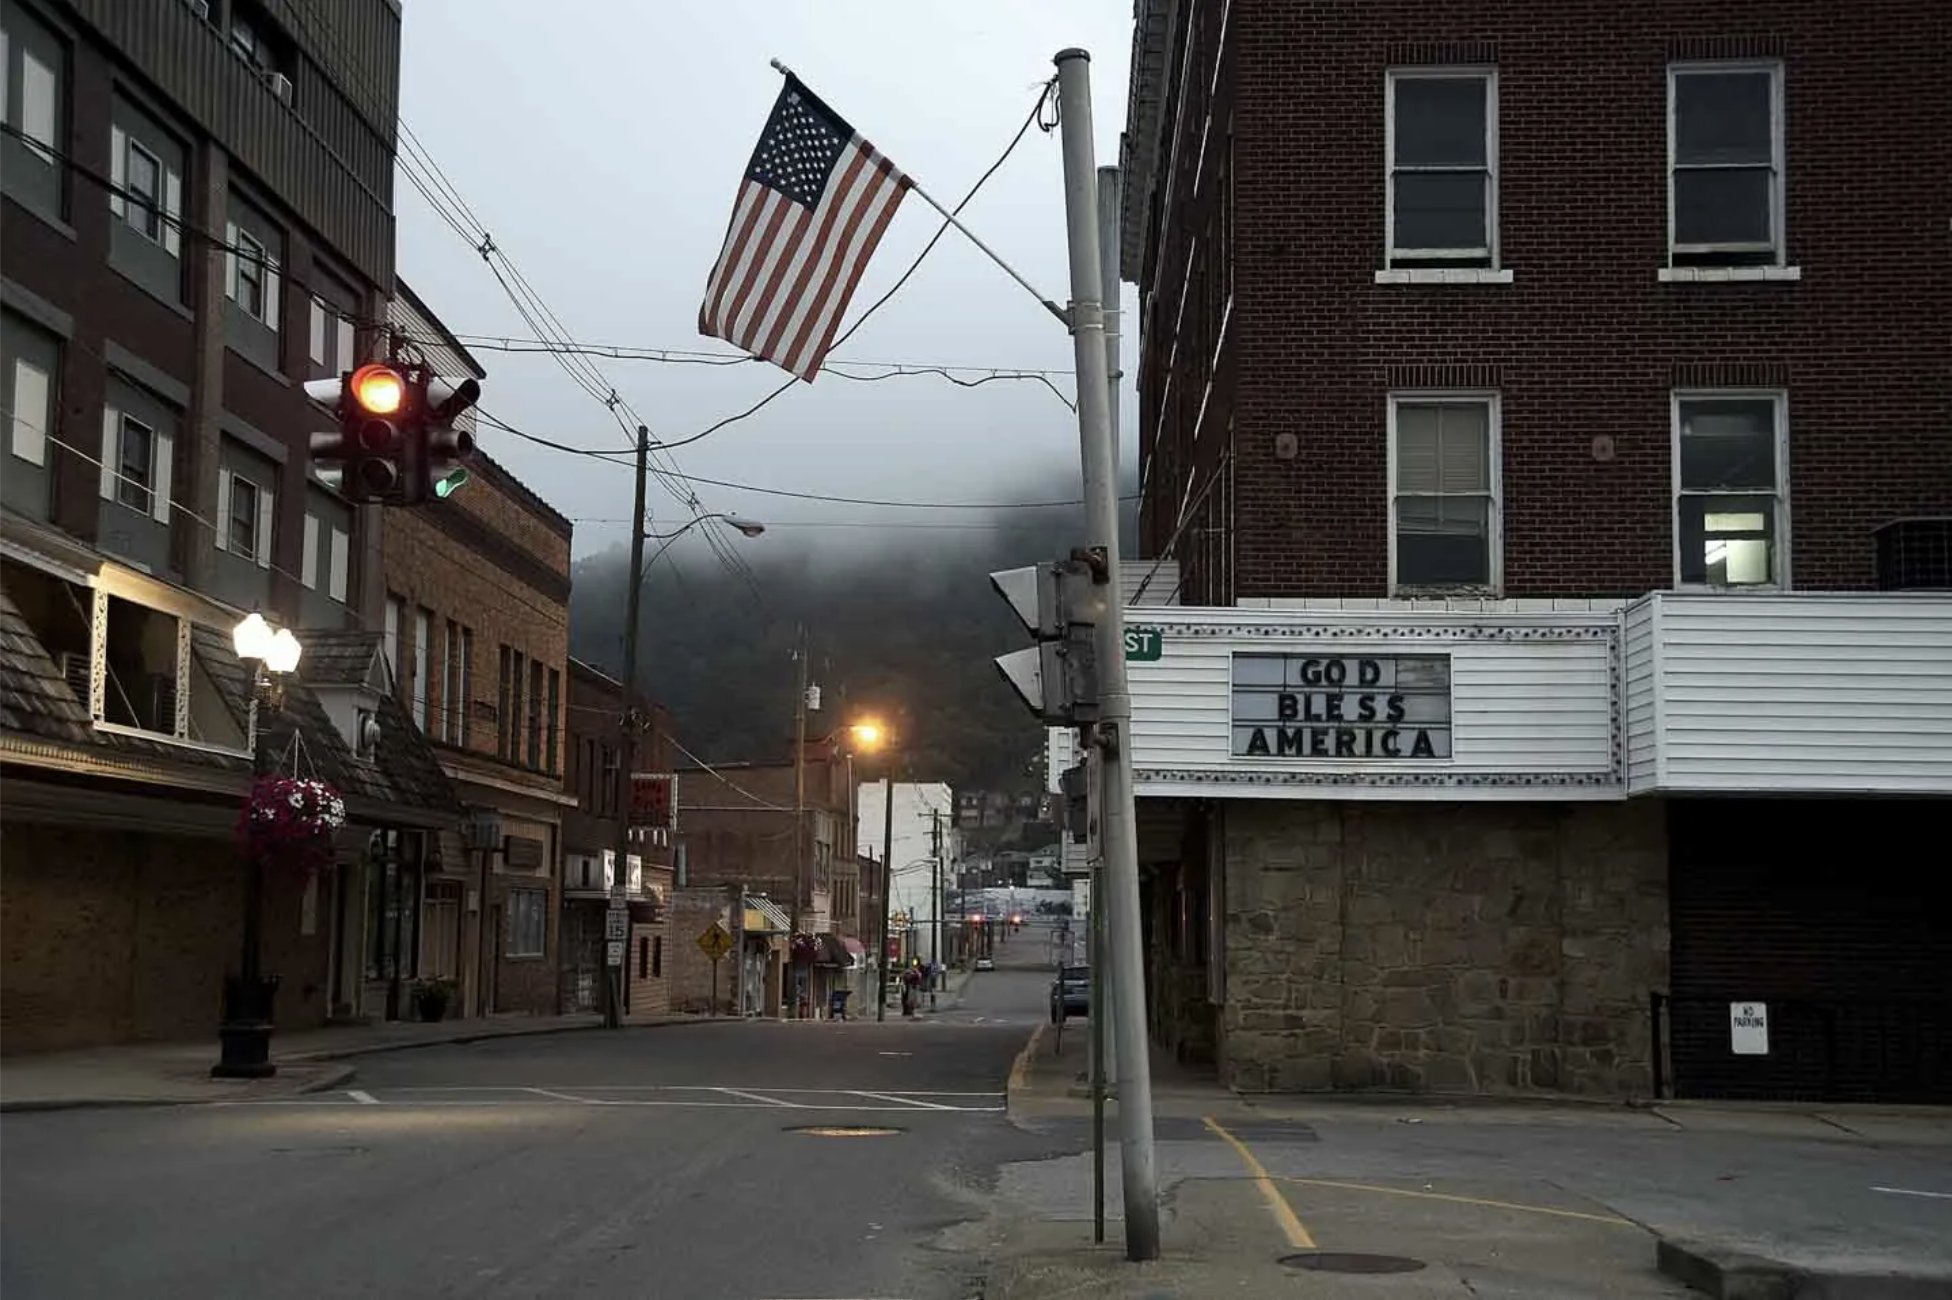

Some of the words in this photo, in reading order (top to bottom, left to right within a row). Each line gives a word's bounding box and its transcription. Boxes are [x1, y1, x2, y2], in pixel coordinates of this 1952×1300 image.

[1125, 632, 1154, 653] ST
[1301, 659, 1381, 686] GOD
[1278, 693, 1406, 722] BLESS
[1246, 727, 1436, 758] AMERICA
